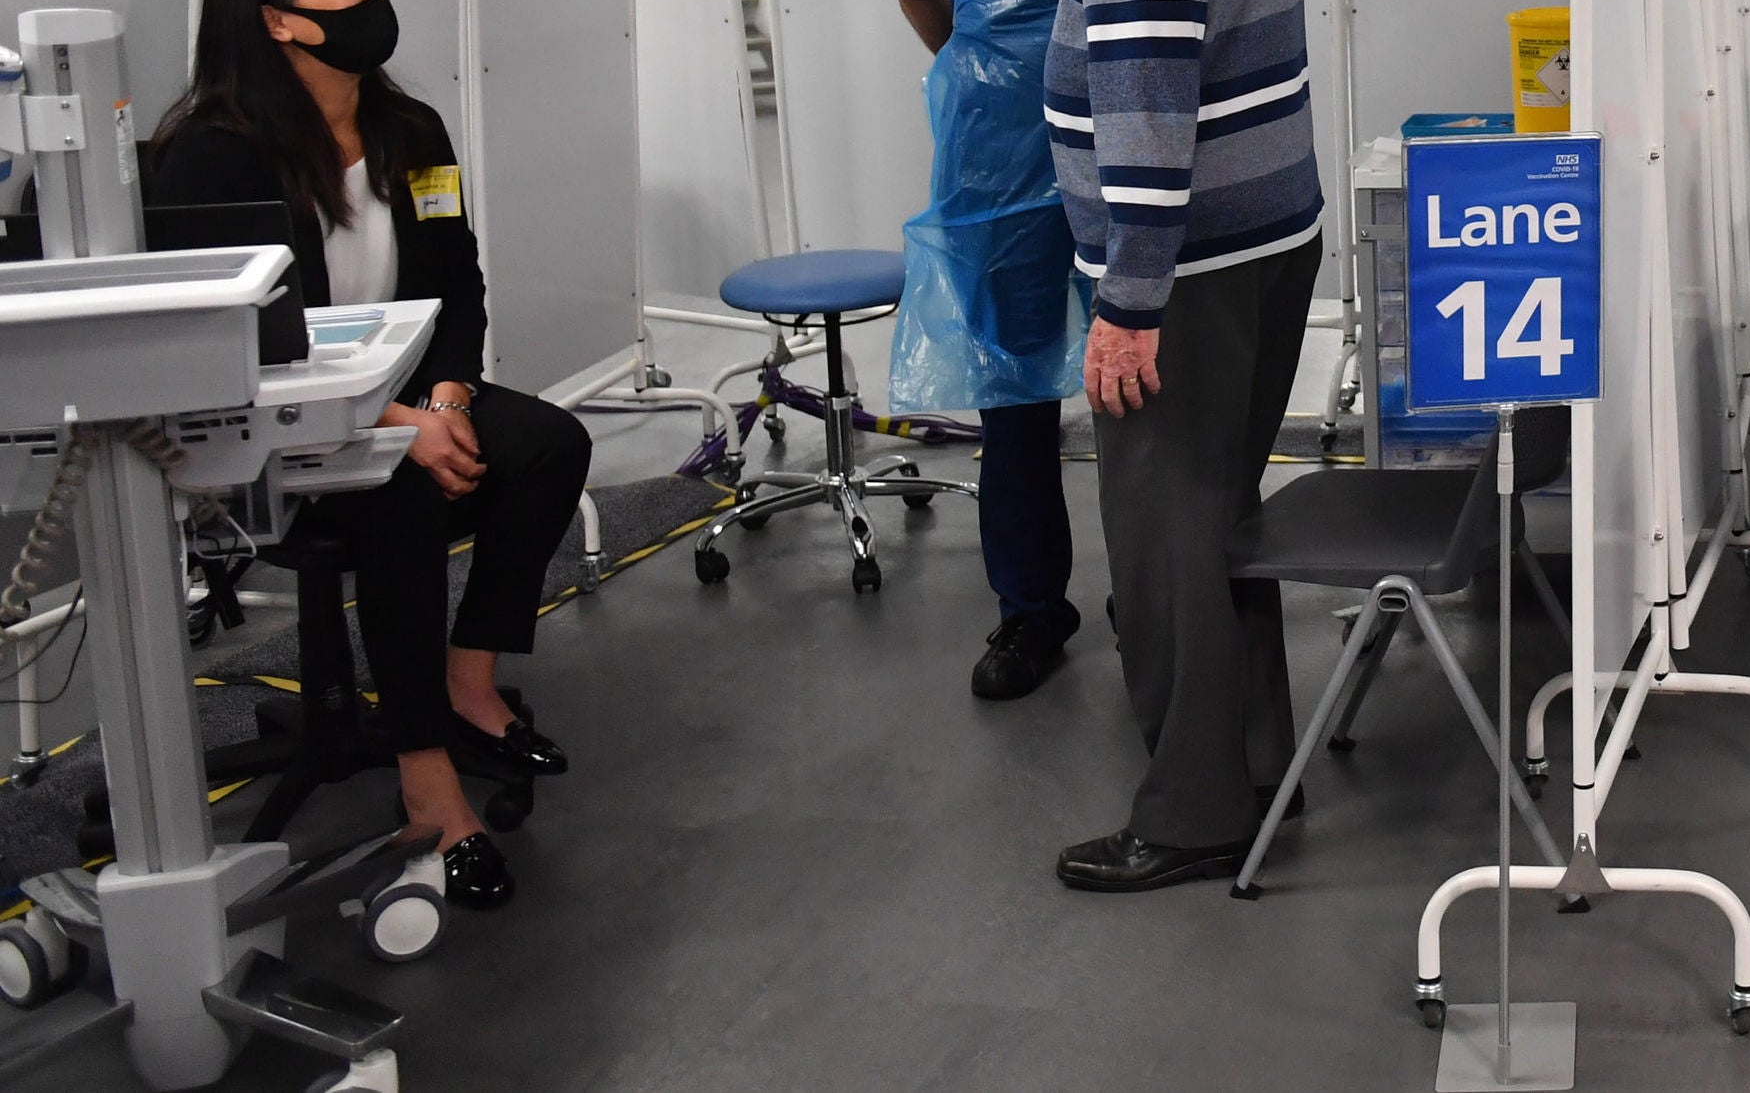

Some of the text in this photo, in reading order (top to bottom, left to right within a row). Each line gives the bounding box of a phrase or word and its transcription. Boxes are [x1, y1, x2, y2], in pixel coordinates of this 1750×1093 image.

[1557, 155, 1578, 164] NHS
[1427, 195, 1581, 248] Lane
[1435, 277, 1574, 381] 14
